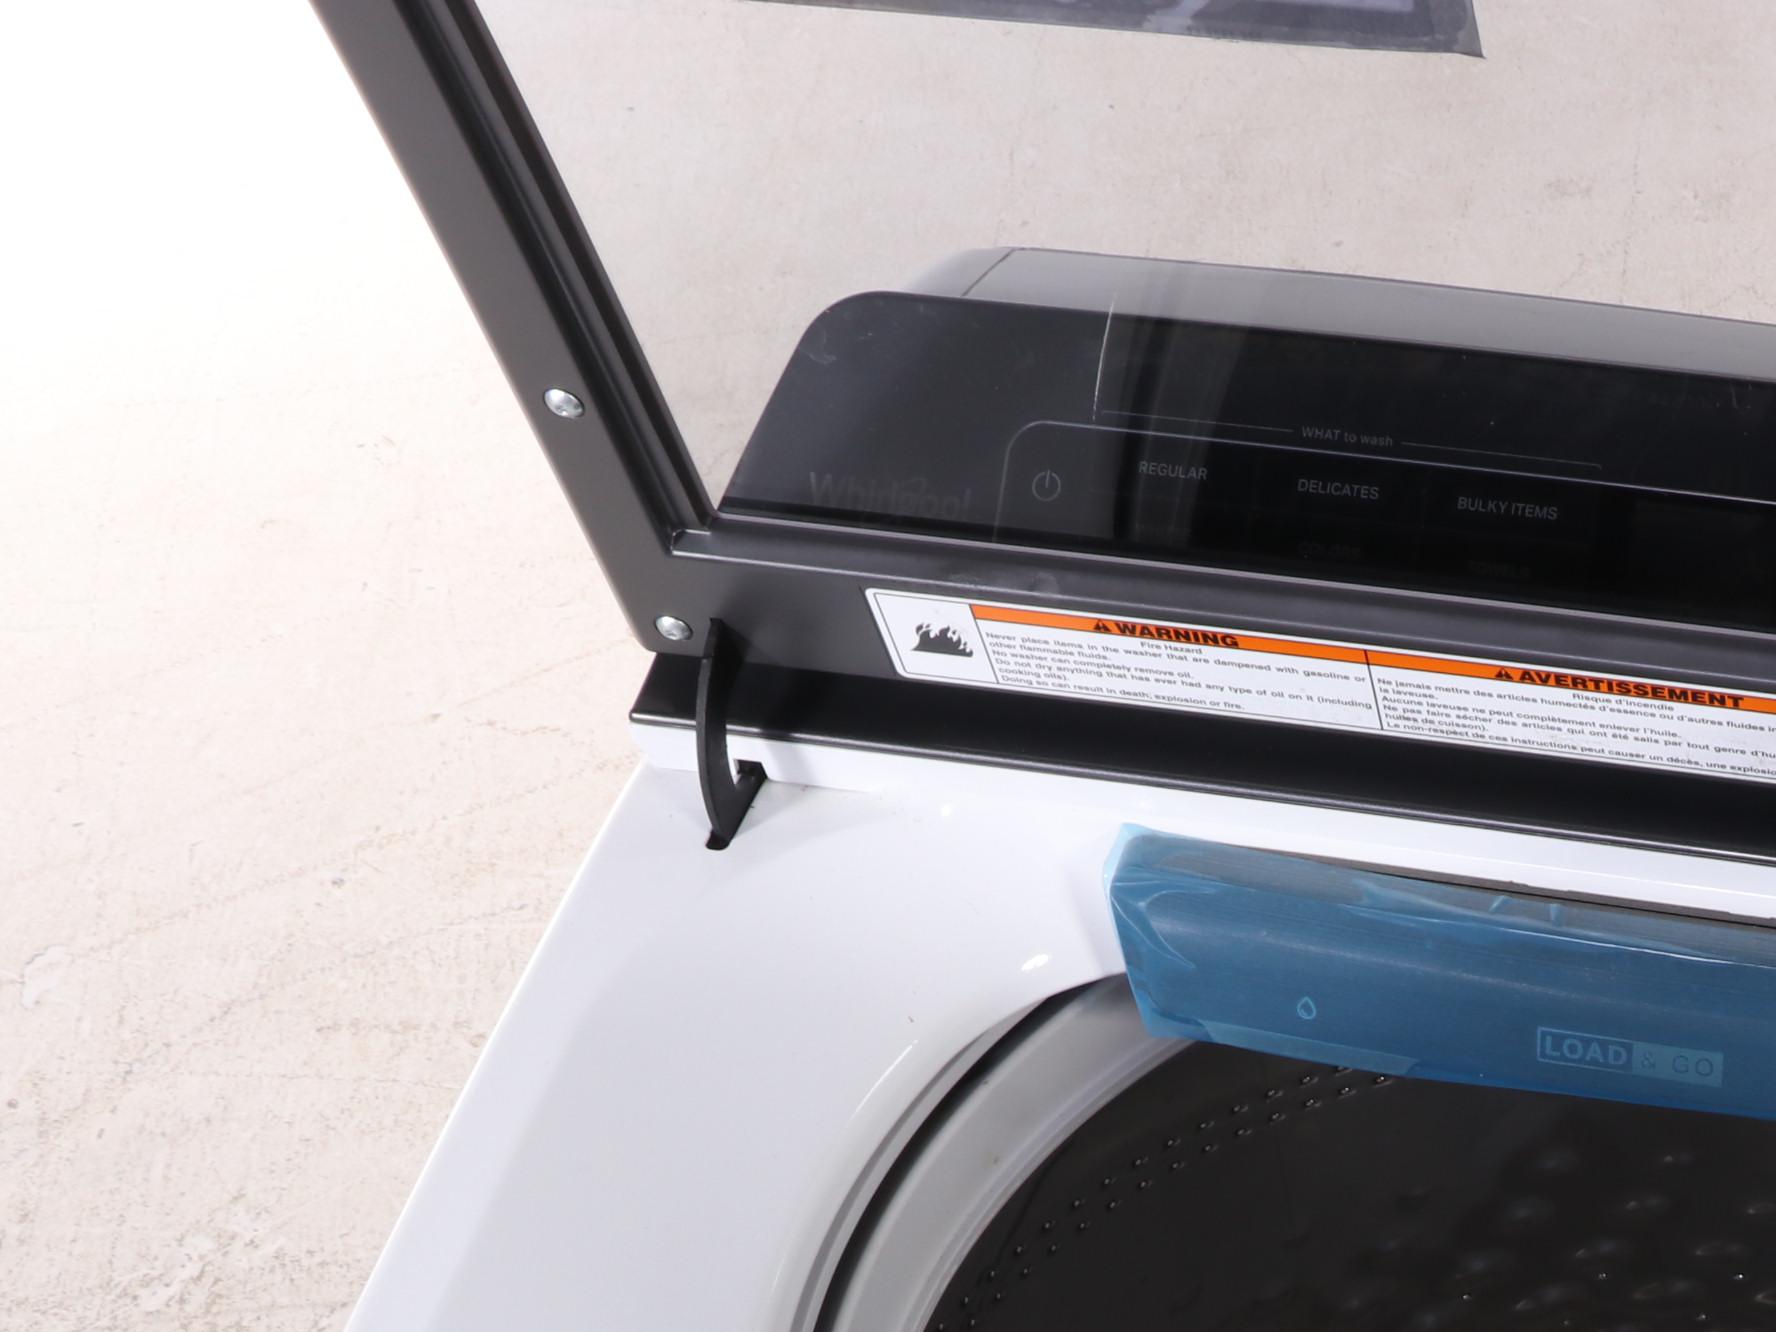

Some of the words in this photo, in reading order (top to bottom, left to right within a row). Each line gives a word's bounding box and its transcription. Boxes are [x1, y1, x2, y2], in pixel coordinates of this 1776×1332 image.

[1301, 426, 1341, 441] WHAT
[1344, 431, 1356, 443] to
[1361, 433, 1393, 447] wash
[1138, 460, 1208, 481] REGULAR
[1297, 478, 1380, 500] DELICATES
[1457, 496, 1508, 514] BULKY
[1511, 503, 1558, 521] ITEMS
[1114, 623, 1239, 648] WARNING
[1139, 641, 1161, 649] Fire
[1163, 644, 1202, 654] Hazard
[984, 631, 1017, 641] Never
[1019, 635, 1050, 647] place
[1052, 639, 1083, 649] items
[1100, 645, 1120, 653] the
[1122, 647, 1162, 658] washer
[1165, 652, 1188, 661] that
[1213, 658, 1271, 673] dampened
[1274, 665, 1298, 674] with
[1302, 668, 1350, 682] gasoline
[987, 640, 1016, 649] other
[1018, 643, 1075, 656] flammable
[1076, 650, 1111, 660] fluids.
[1009, 651, 1049, 662] washer
[1071, 658, 1132, 673] completely
[1133, 667, 1175, 677] remove
[1177, 670, 1193, 679] oil.
[1000, 674, 1033, 686] Doing
[1072, 683, 1104, 693] result
[1153, 693, 1207, 707] explosion
[1222, 701, 1244, 710] fire.
[1391, 688, 1438, 699] laveuse.
[1519, 671, 1745, 710] AVERTISSEMENT
[1572, 692, 1612, 704] Risque
[1380, 695, 1423, 706] Aucune
[1426, 700, 1469, 712] laveuse
[1488, 708, 1513, 719] peut
[1598, 722, 1640, 733] enlever
[1394, 679, 1432, 692] jamais
[1434, 684, 1469, 695] mettre
[1472, 689, 1493, 697] des
[1495, 692, 1537, 703] articles
[1726, 720, 1765, 731] fluides
[1545, 1036, 1628, 1065] LOAD
[1641, 1050, 1656, 1070] &
[1671, 1055, 1714, 1077] GO
